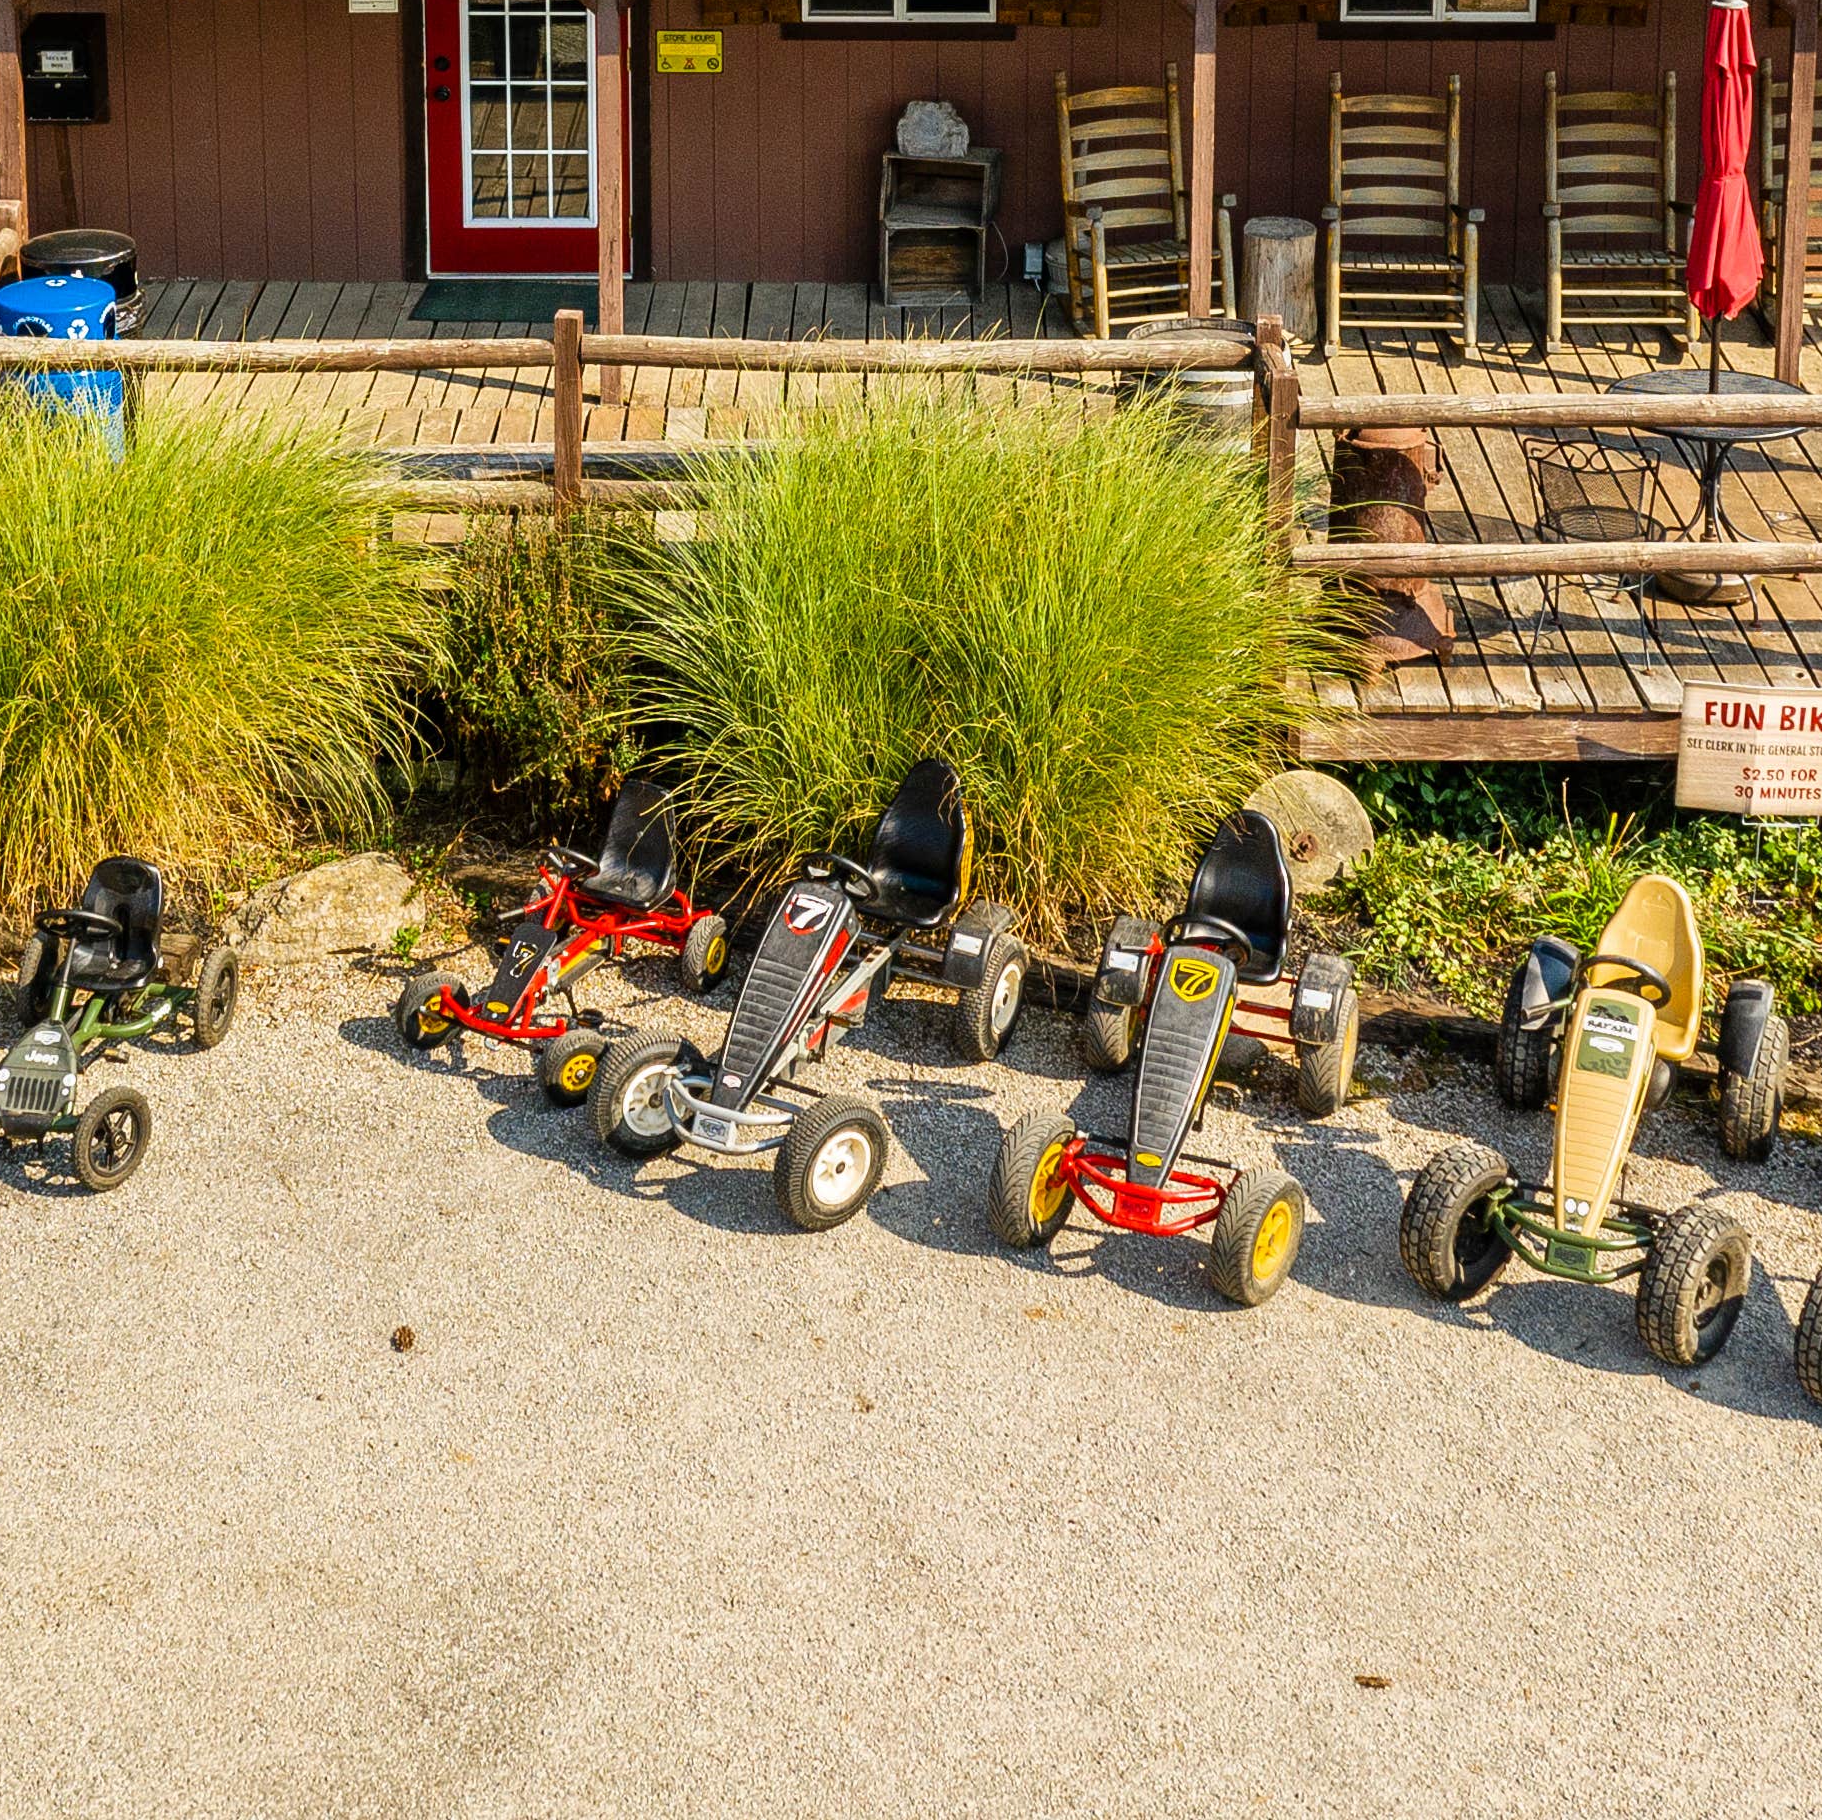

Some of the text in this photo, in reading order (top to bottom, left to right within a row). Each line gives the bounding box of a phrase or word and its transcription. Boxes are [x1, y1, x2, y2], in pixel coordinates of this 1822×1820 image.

[664, 34, 716, 42] STORE HOURS
[1705, 701, 1766, 731] FUN
[1687, 737, 1703, 749] SEE
[1705, 739, 1734, 752] CLERK
[1736, 742, 1746, 754] IN
[1749, 743, 1766, 755] THE
[1768, 744, 1807, 757] GENERAL
[1742, 767, 1818, 782] $2.50 FOR
[1734, 785, 1822, 800] 30 MINUTES
[792, 899, 829, 929] 7
[1179, 964, 1214, 995] 7
[24, 1050, 60, 1066] Jeep
